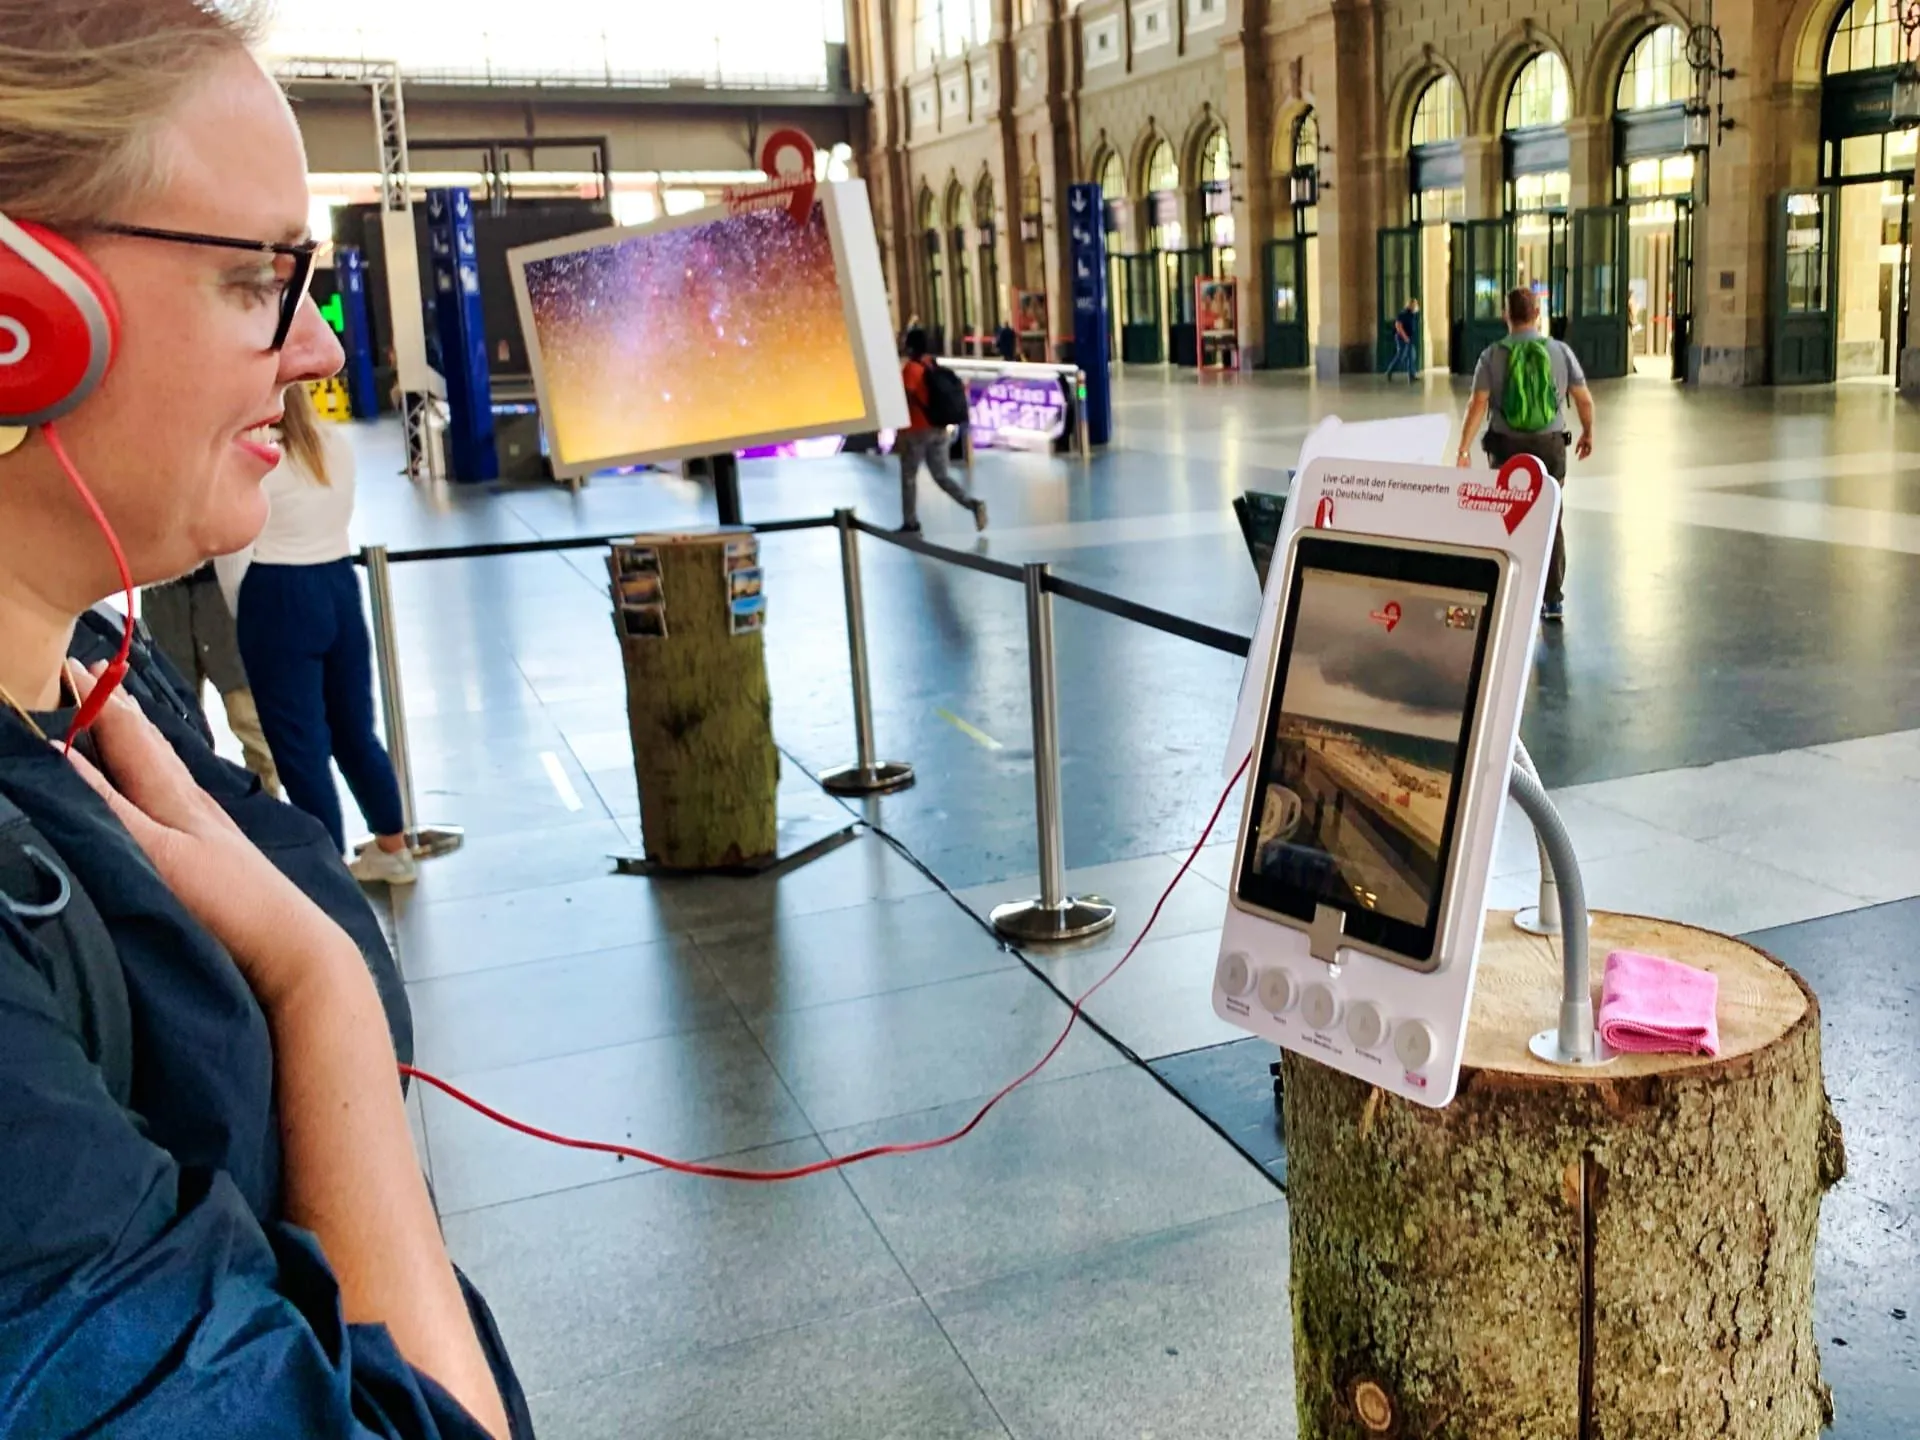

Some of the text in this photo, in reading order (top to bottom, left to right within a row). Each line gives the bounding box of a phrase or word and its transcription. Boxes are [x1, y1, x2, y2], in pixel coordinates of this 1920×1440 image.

[1356, 478, 1370, 487] mit
[1371, 480, 1386, 489] den
[1388, 480, 1450, 494] Ferienexperten
[1457, 483, 1533, 502] #Wanderlust
[1320, 488, 1384, 502] aus Deutschland
[1458, 497, 1512, 516] Germany
